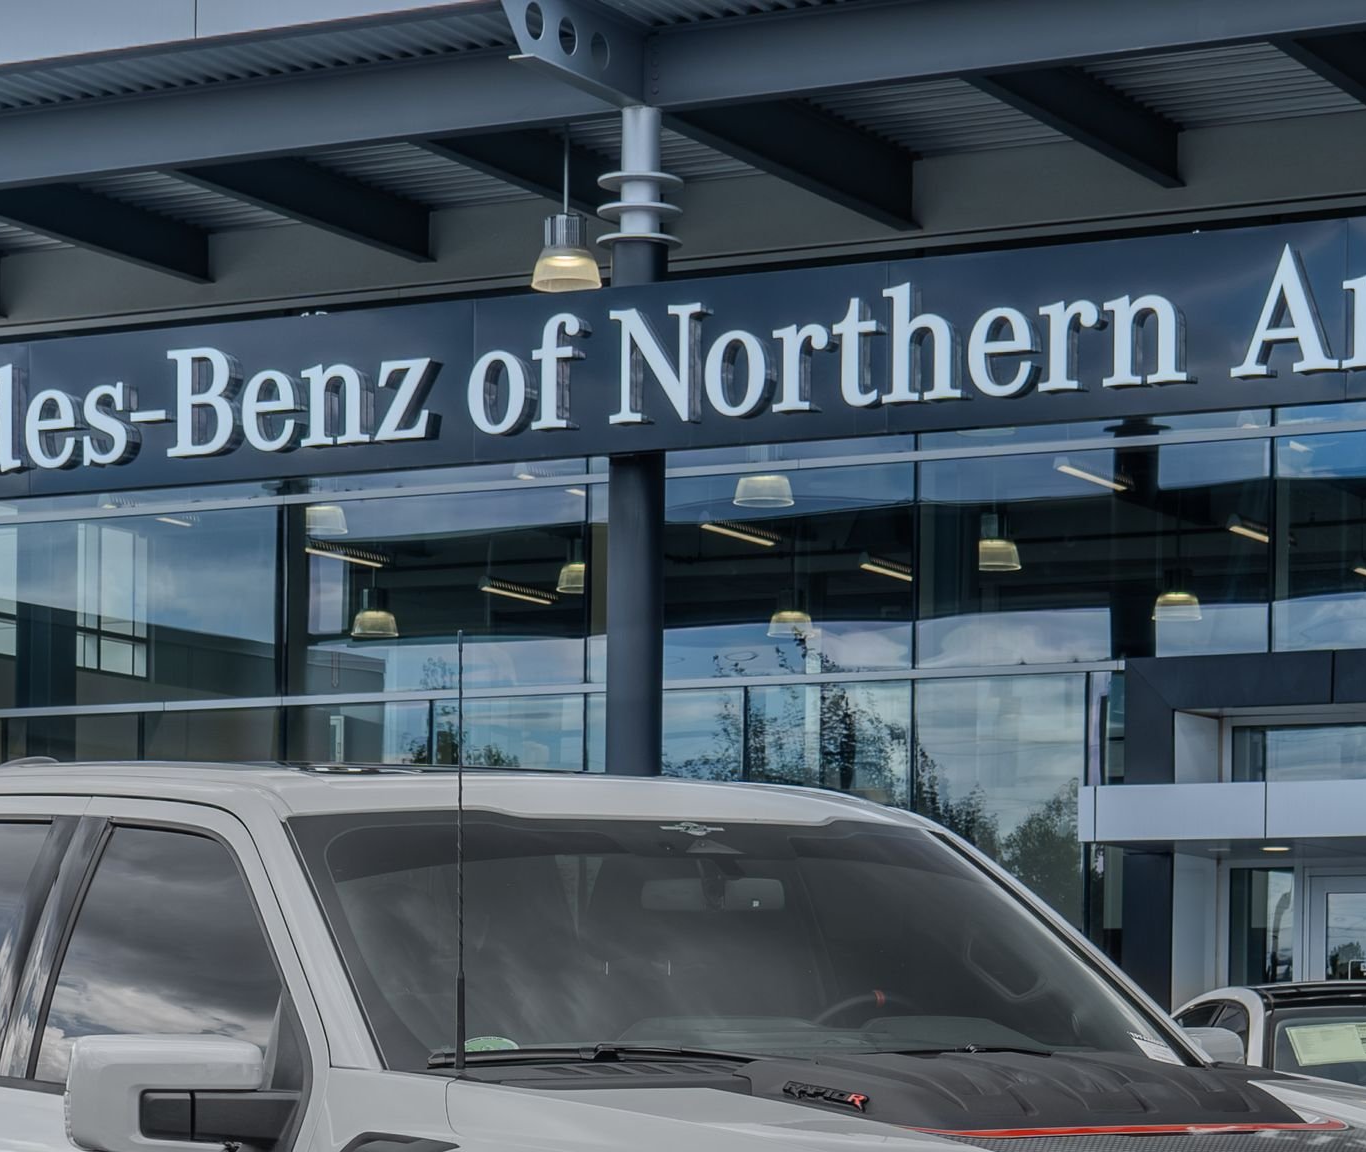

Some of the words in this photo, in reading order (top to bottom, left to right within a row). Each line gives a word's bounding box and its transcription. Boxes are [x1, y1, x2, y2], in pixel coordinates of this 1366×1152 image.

[465, 312, 588, 437] of
[608, 281, 1192, 426] Northern
[782, 1080, 870, 1113] RAPTOR
